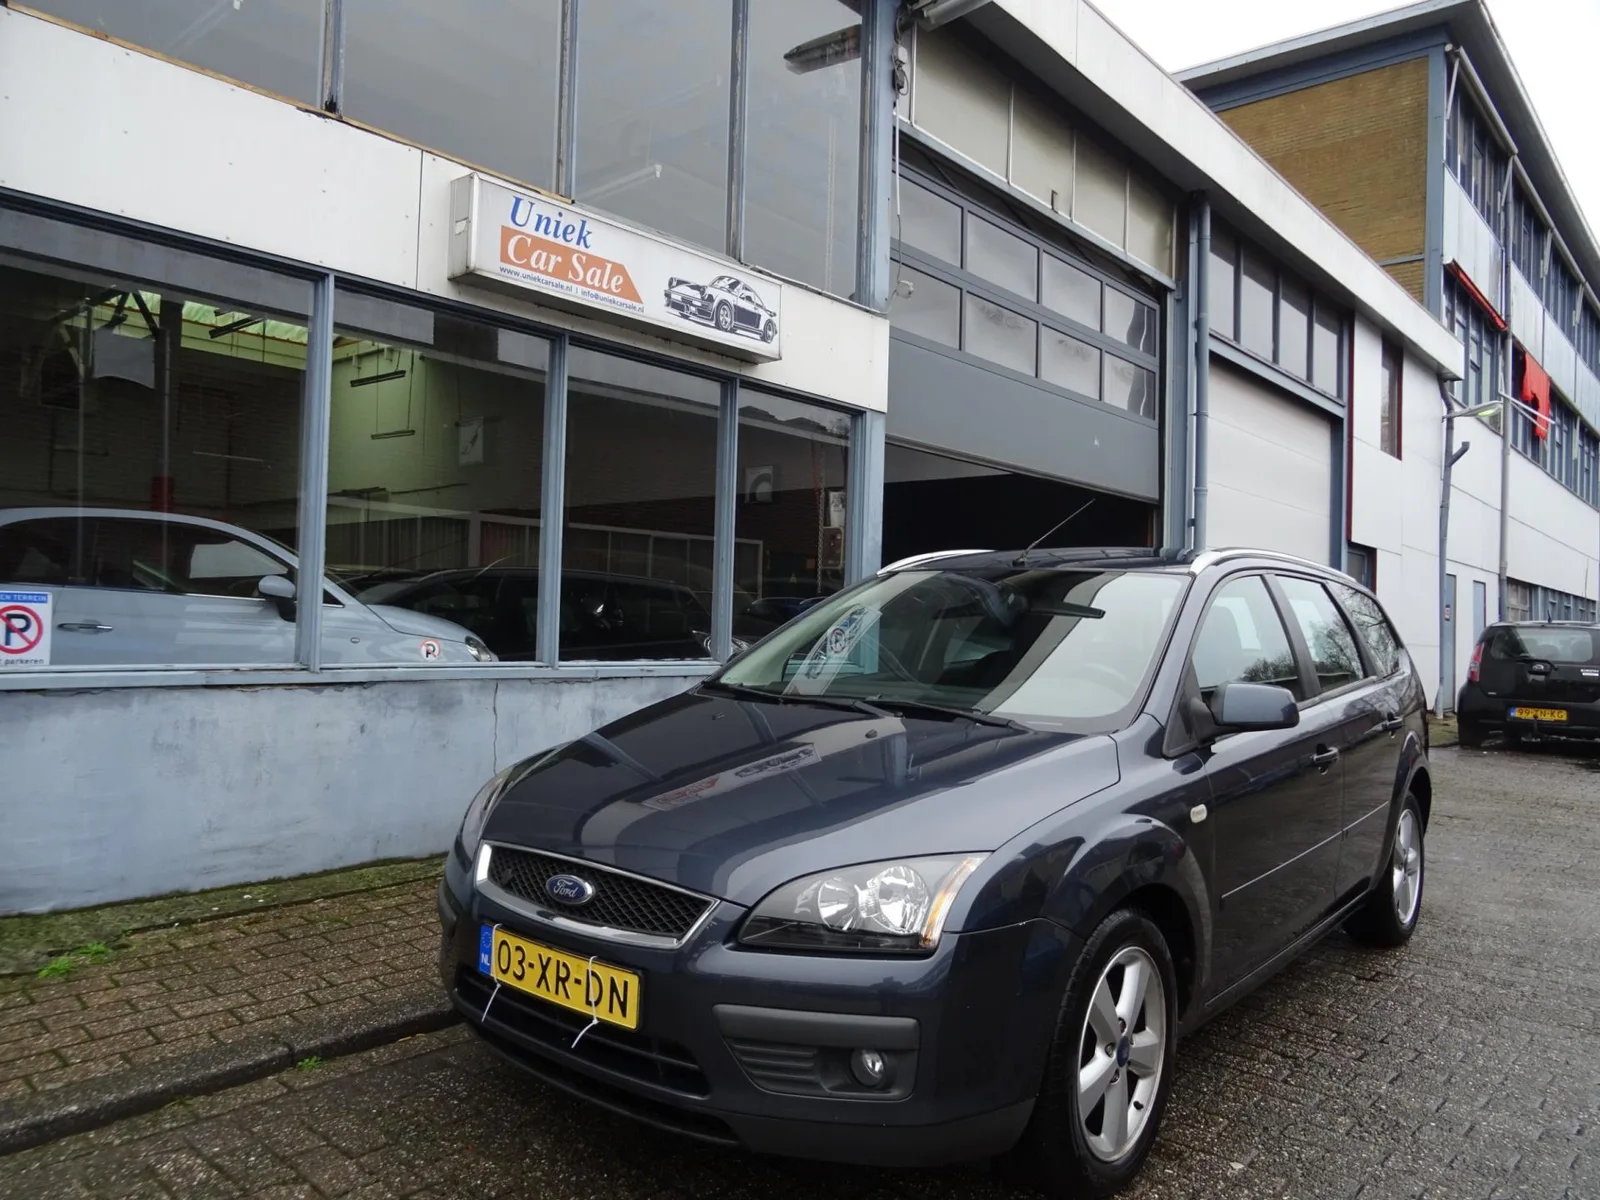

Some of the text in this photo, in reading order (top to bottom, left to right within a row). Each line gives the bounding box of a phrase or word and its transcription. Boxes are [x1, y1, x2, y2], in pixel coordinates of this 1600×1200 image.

[510, 196, 592, 249] Uniek
[500, 266, 645, 314] www.uniekcarsale.nl info@uniekcarsale.nl
[507, 234, 624, 293] Car Sale
[553, 879, 579, 898] Ford
[497, 939, 628, 1018] 03-XR-DN
